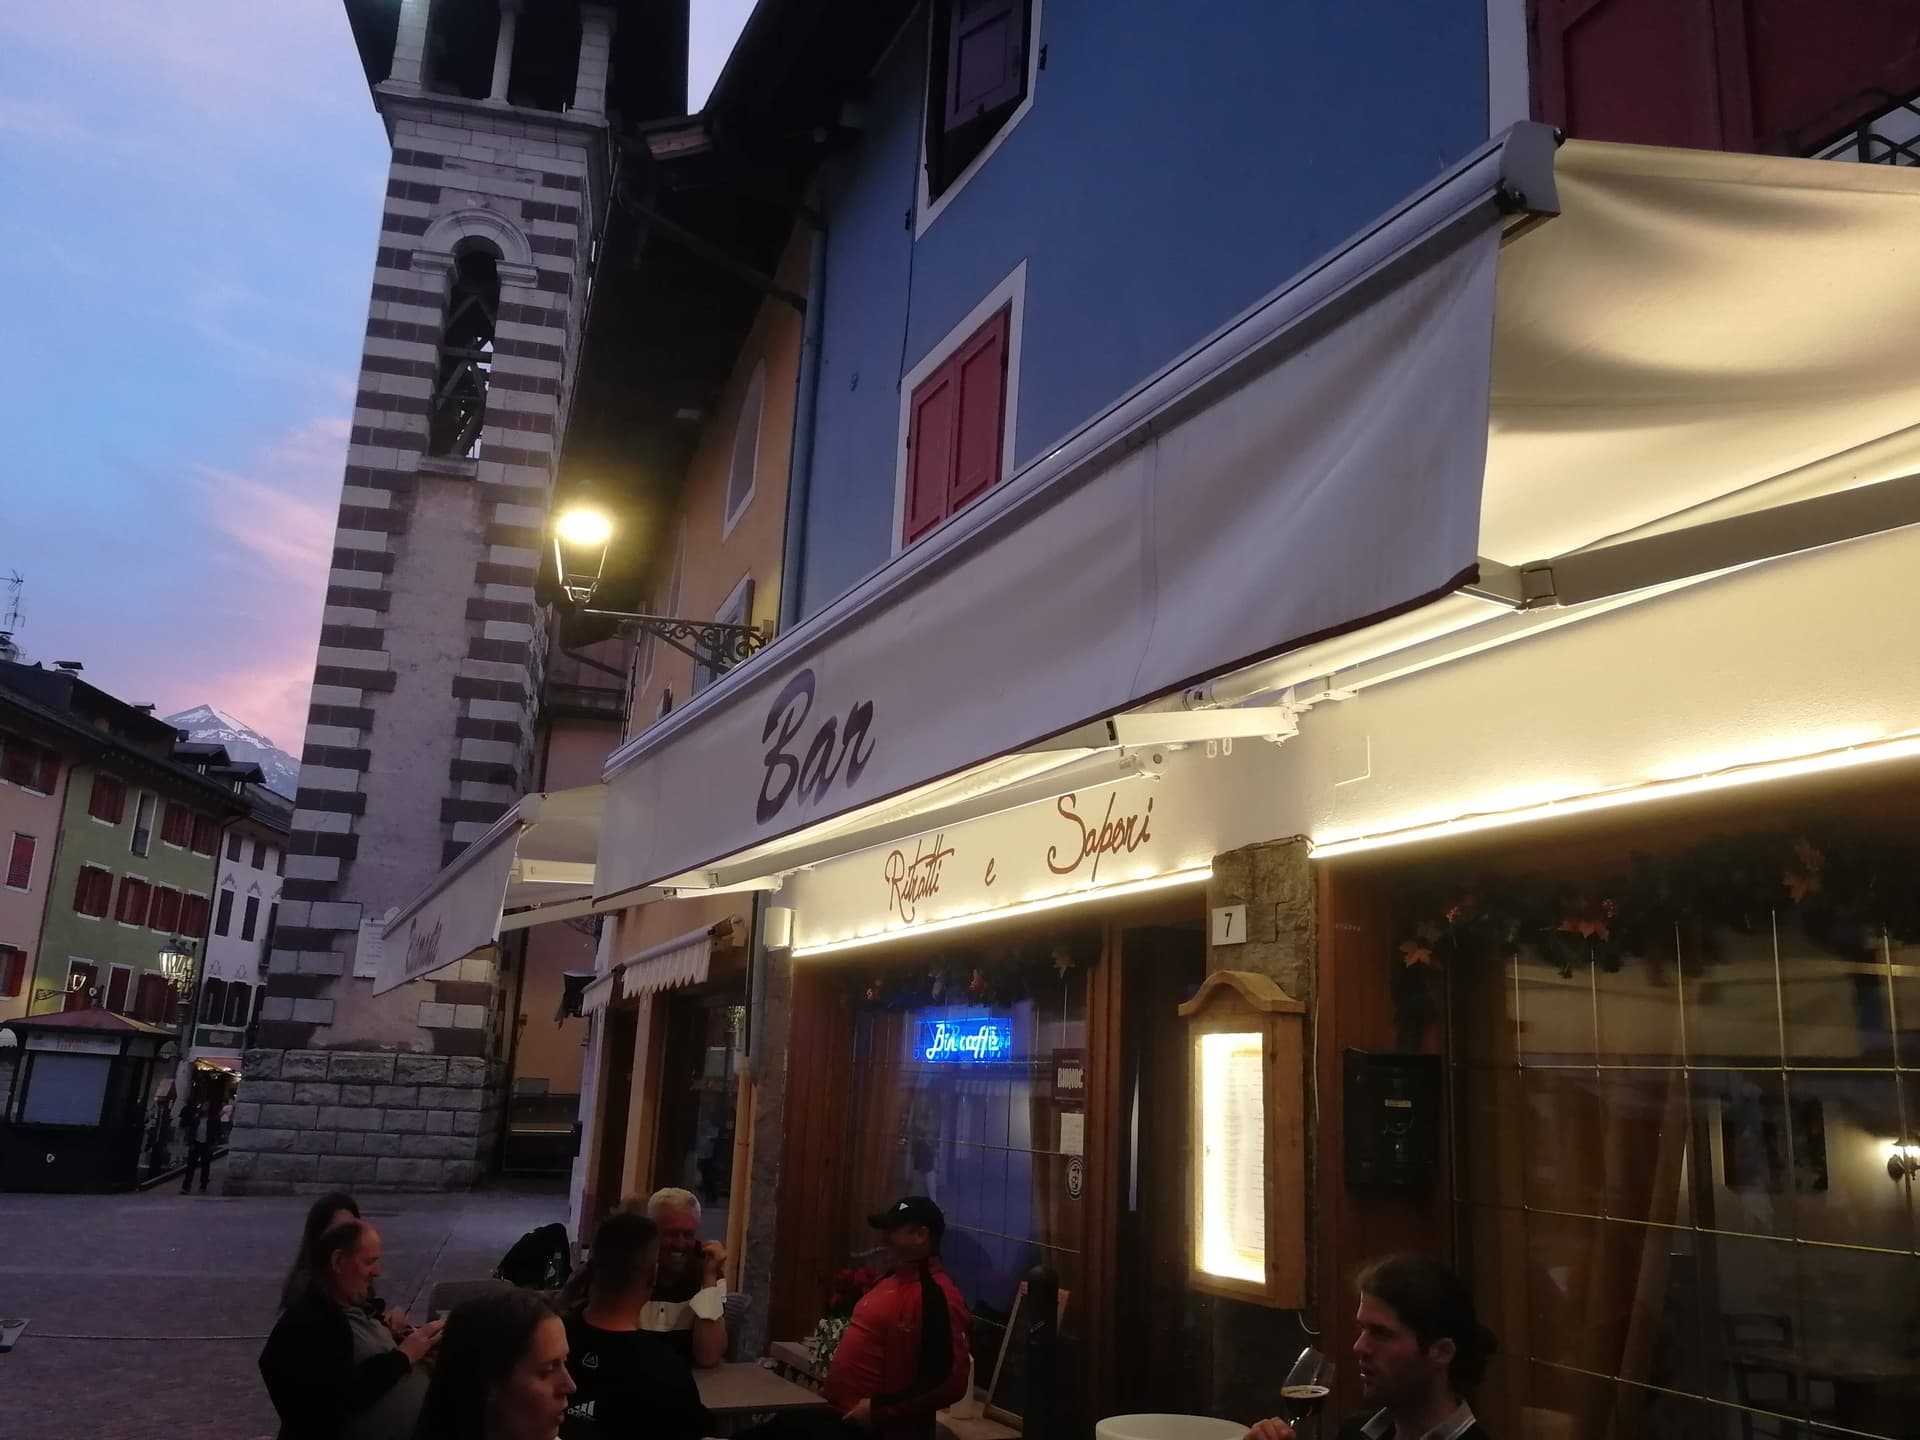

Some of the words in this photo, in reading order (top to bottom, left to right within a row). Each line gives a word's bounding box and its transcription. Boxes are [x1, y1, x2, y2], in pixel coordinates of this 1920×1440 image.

[756, 668, 876, 826] Bar
[984, 857, 997, 887] e
[1047, 791, 1154, 883] Sapori
[1224, 912, 1233, 938] 7
